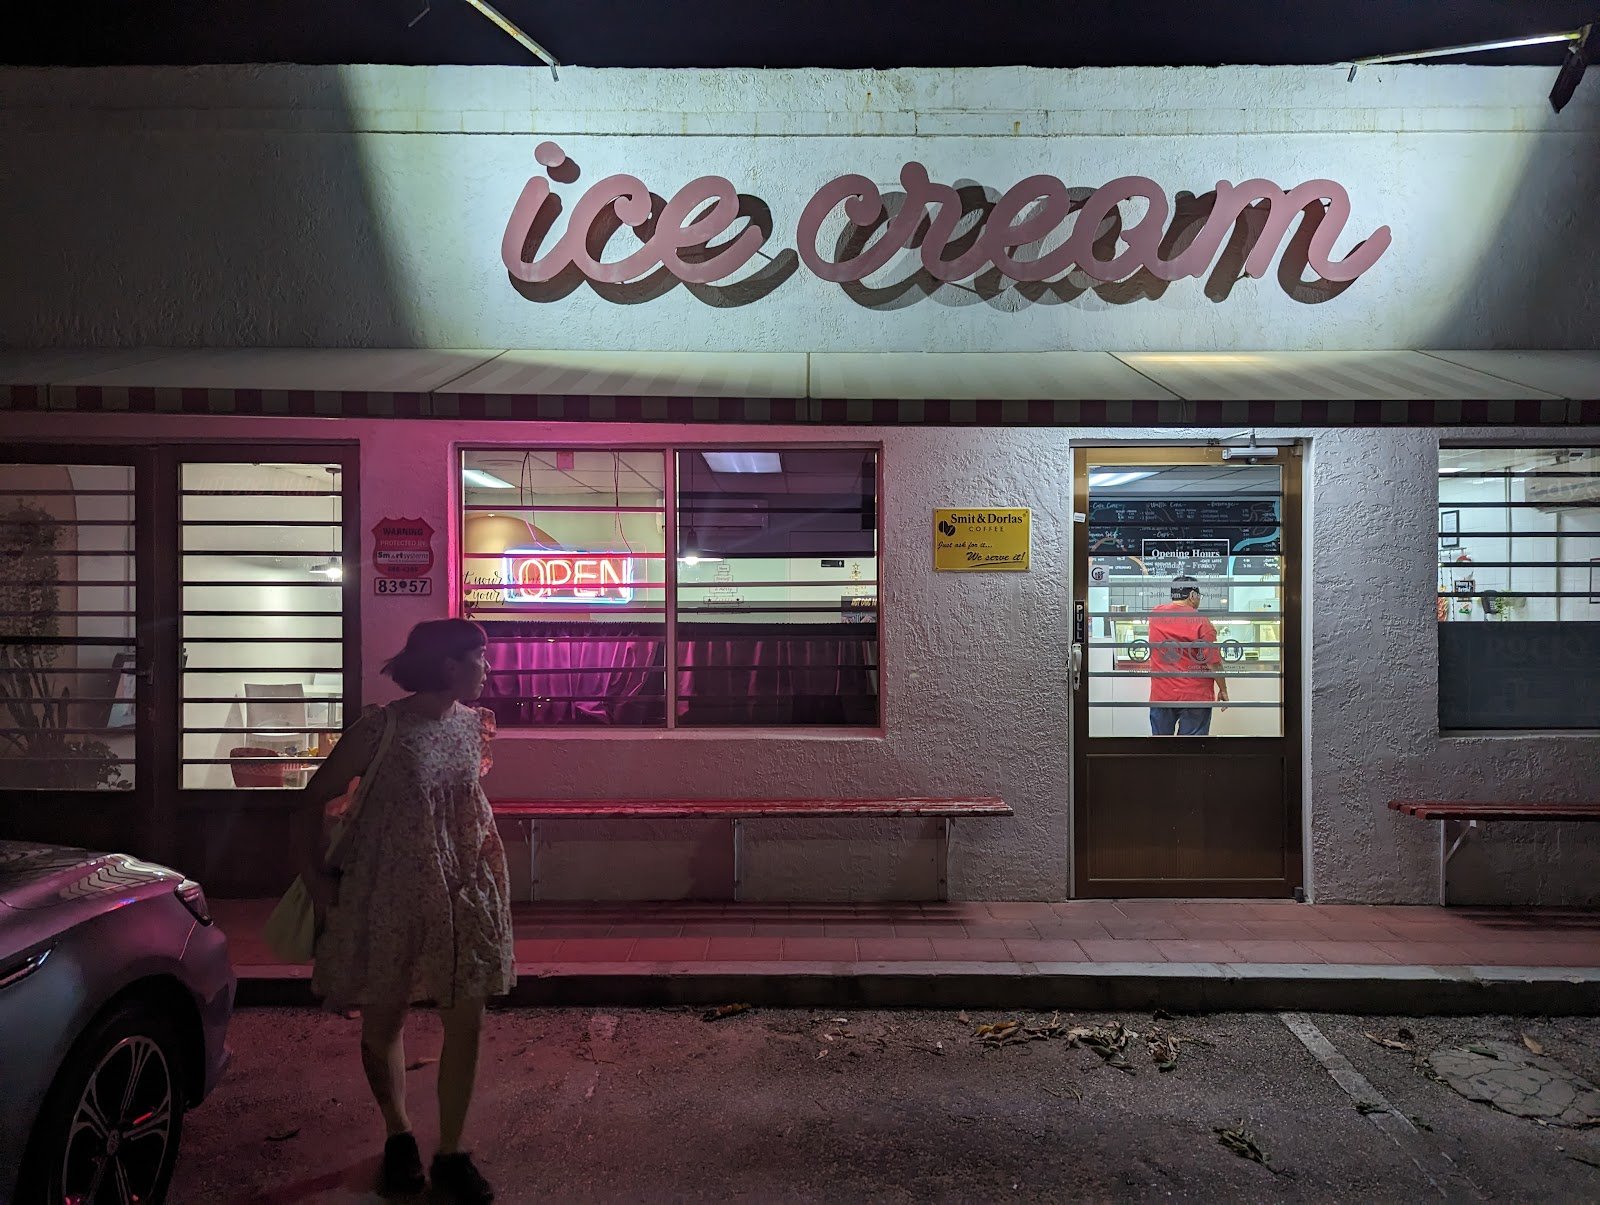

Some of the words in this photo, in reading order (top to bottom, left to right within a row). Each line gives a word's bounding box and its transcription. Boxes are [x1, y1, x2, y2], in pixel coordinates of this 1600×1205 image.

[501, 141, 764, 283] ice
[797, 161, 1392, 282] cream
[951, 513, 976, 524] Smit
[988, 513, 1023, 524] Dorlas
[382, 528, 424, 536] WARNING
[937, 541, 953, 550] Just
[967, 541, 978, 549] for
[966, 551, 983, 561] We
[1012, 552, 1026, 561] it!
[1151, 549, 1190, 559] Opening
[1192, 549, 1220, 558] Hours
[518, 558, 628, 598] OPEN
[1076, 604, 1084, 640] PULL
